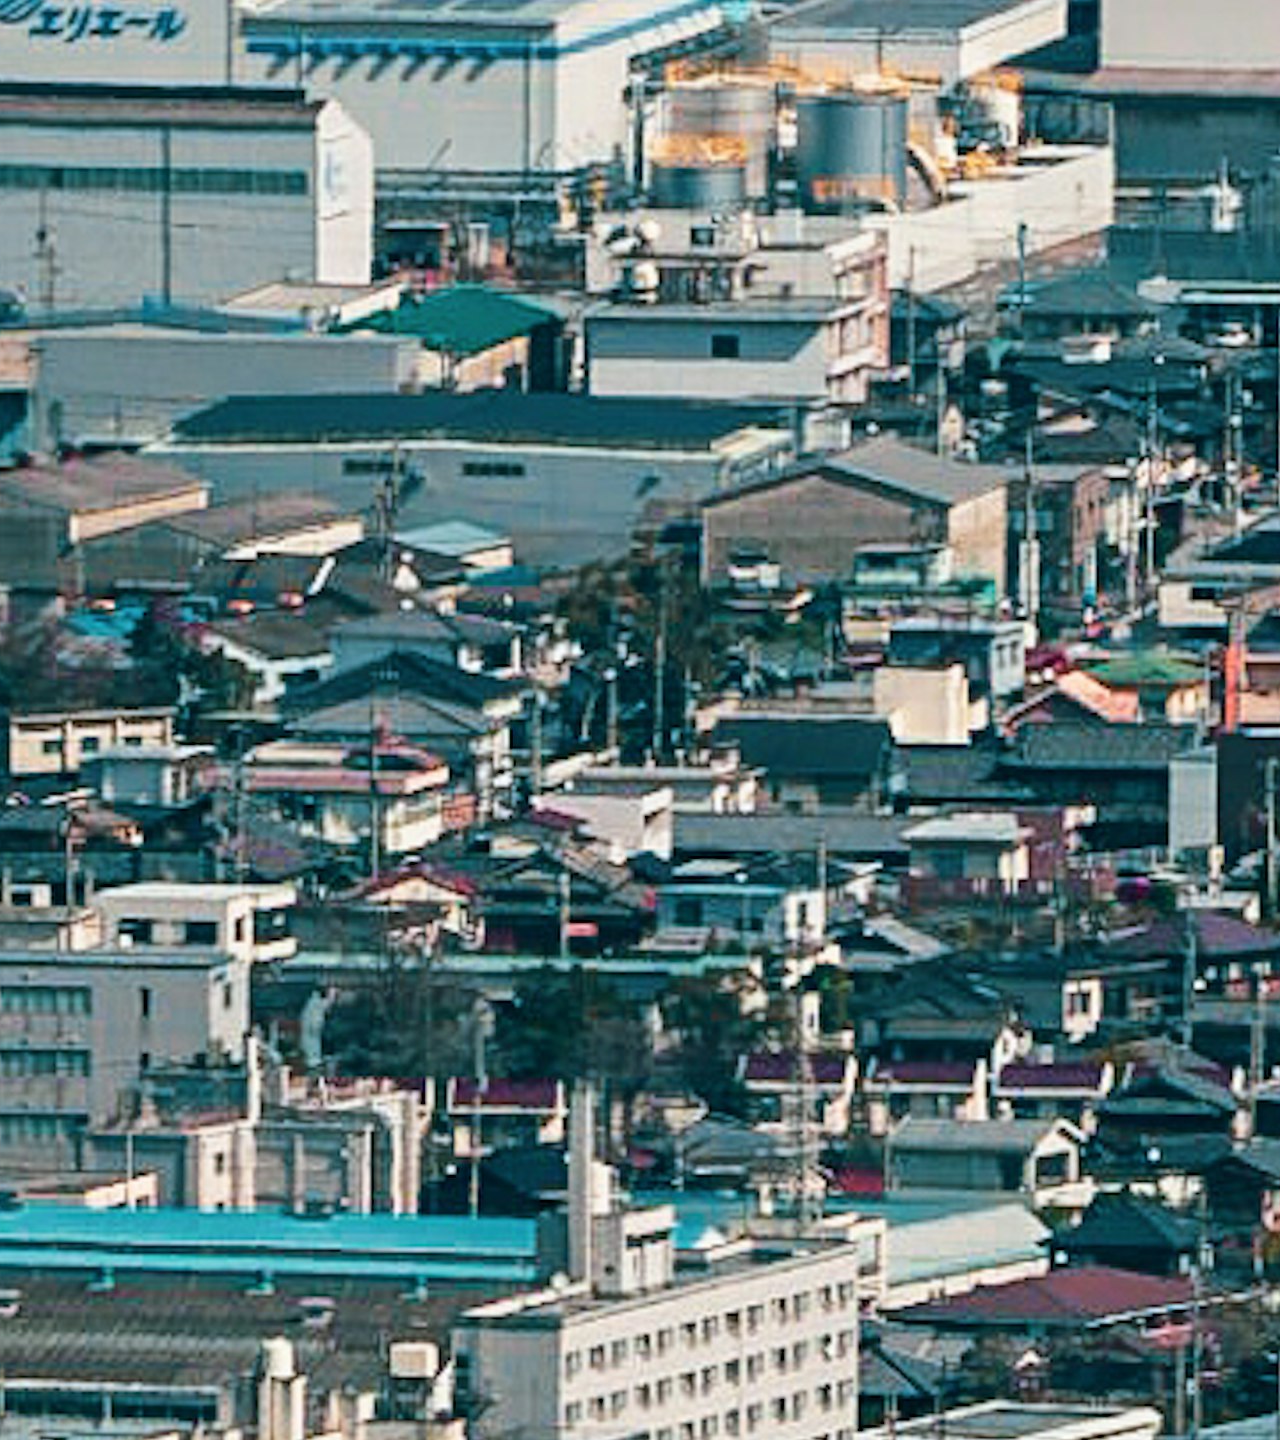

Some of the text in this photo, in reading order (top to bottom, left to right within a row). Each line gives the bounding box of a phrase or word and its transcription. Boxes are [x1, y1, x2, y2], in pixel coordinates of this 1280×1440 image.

[28, 6, 187, 42] エリエール
